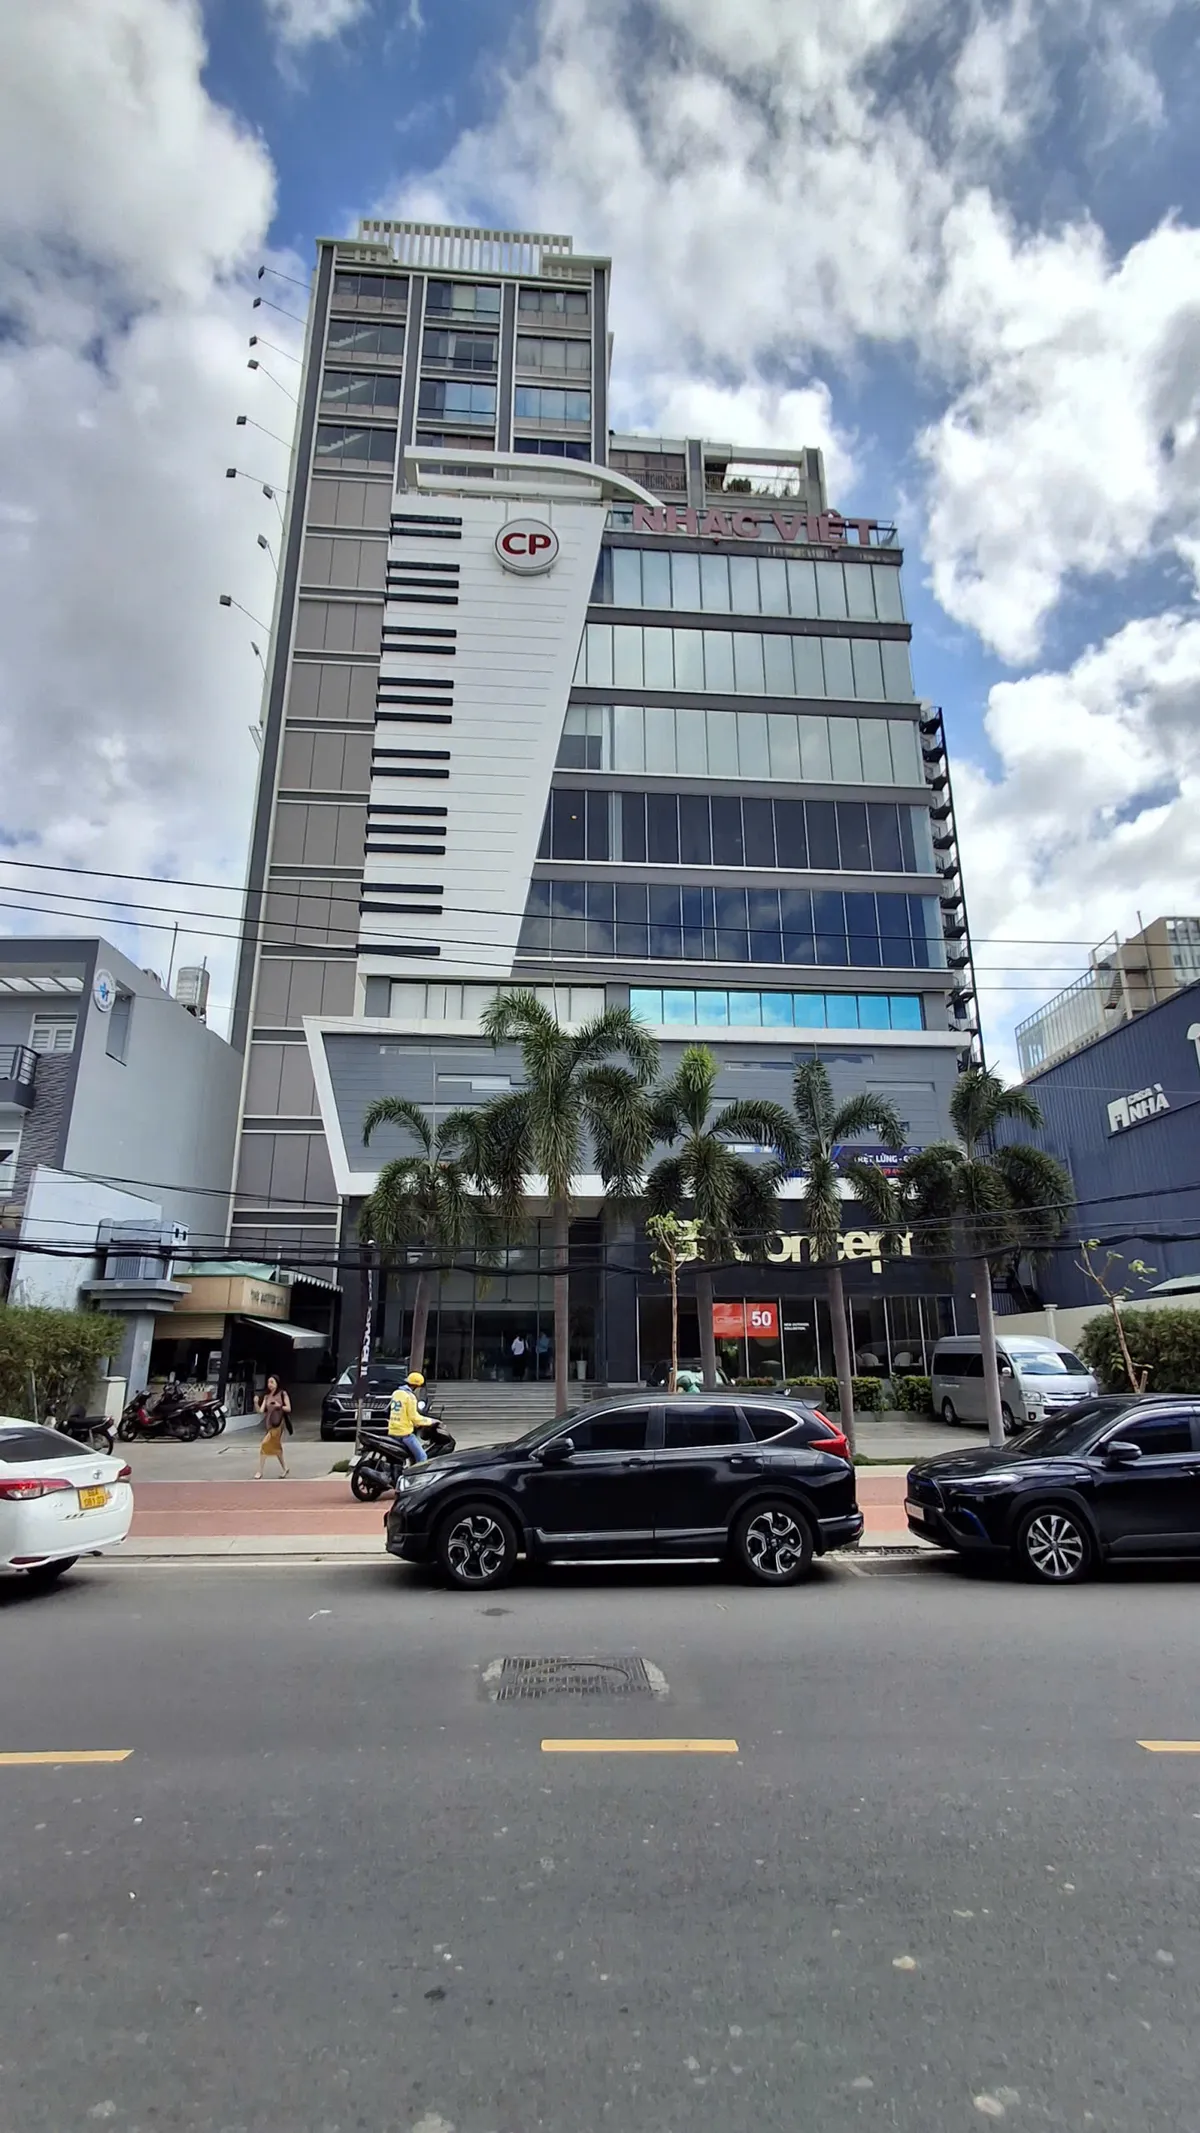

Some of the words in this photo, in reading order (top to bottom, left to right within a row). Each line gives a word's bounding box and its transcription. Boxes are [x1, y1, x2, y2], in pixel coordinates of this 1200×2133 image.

[501, 532, 552, 555] CP
[770, 508, 878, 552] VIỆT
[674, 1219, 915, 1274] Bonept
[751, 1311, 772, 1327] 50
